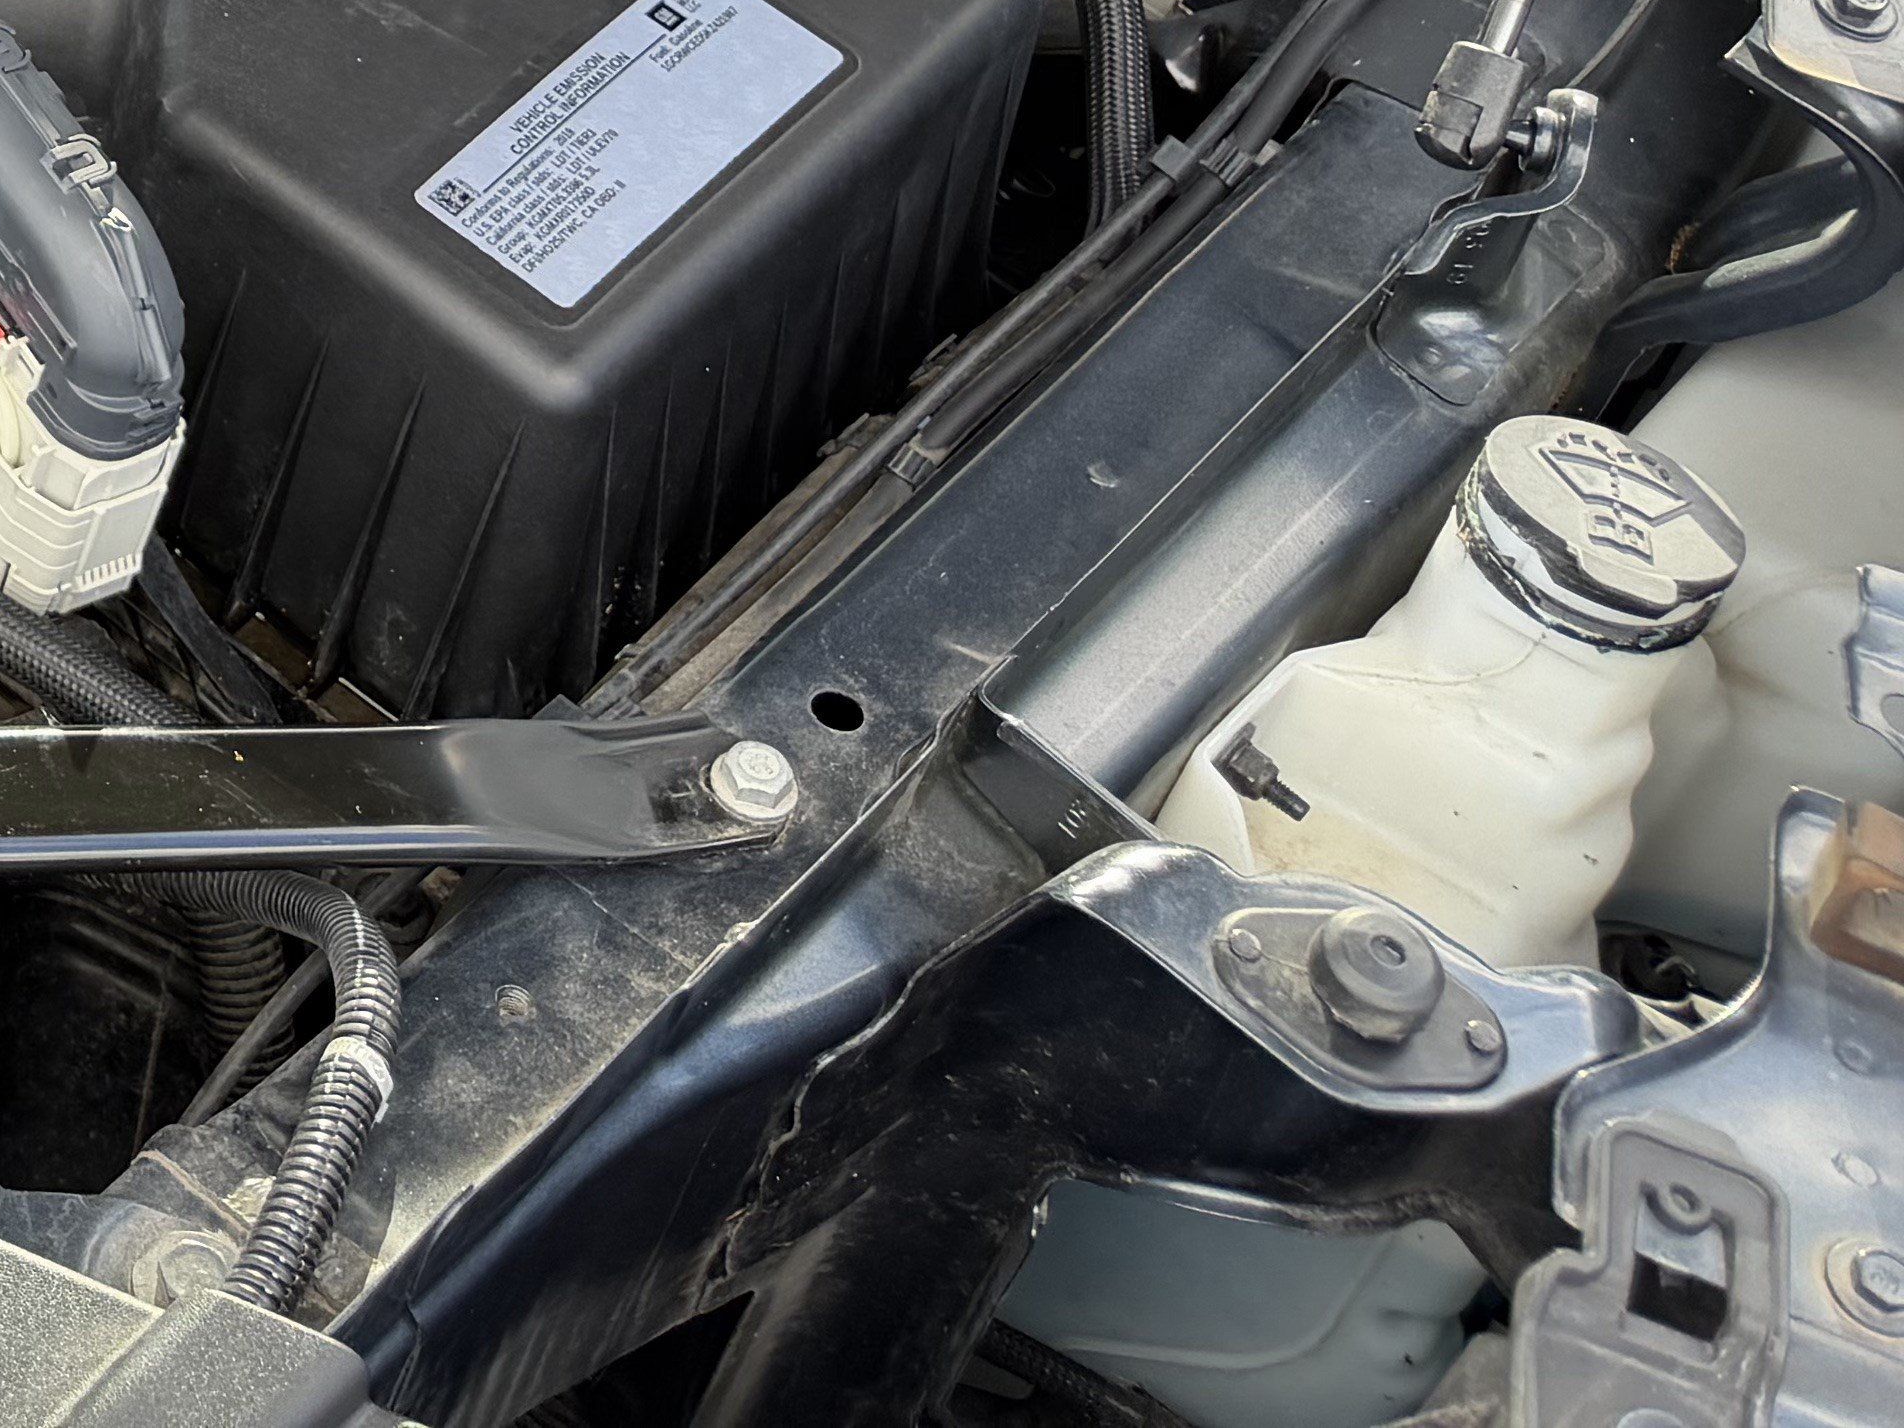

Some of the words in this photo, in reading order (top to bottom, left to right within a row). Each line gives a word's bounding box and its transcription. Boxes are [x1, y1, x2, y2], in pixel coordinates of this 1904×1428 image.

[509, 110, 563, 153] CONTROL
[558, 52, 629, 111] INFORMATION
[510, 94, 557, 132] VEHICLE
[553, 53, 605, 95] EMISSION
[461, 194, 501, 227] Conforms
[474, 221, 493, 236] U.S.
[490, 206, 510, 222] EPA
[506, 188, 530, 207] class
[485, 212, 525, 245] California
[521, 194, 544, 213] class
[580, 204, 599, 218] CA
[497, 228, 530, 255] Group:
[509, 241, 536, 263] Evap:
